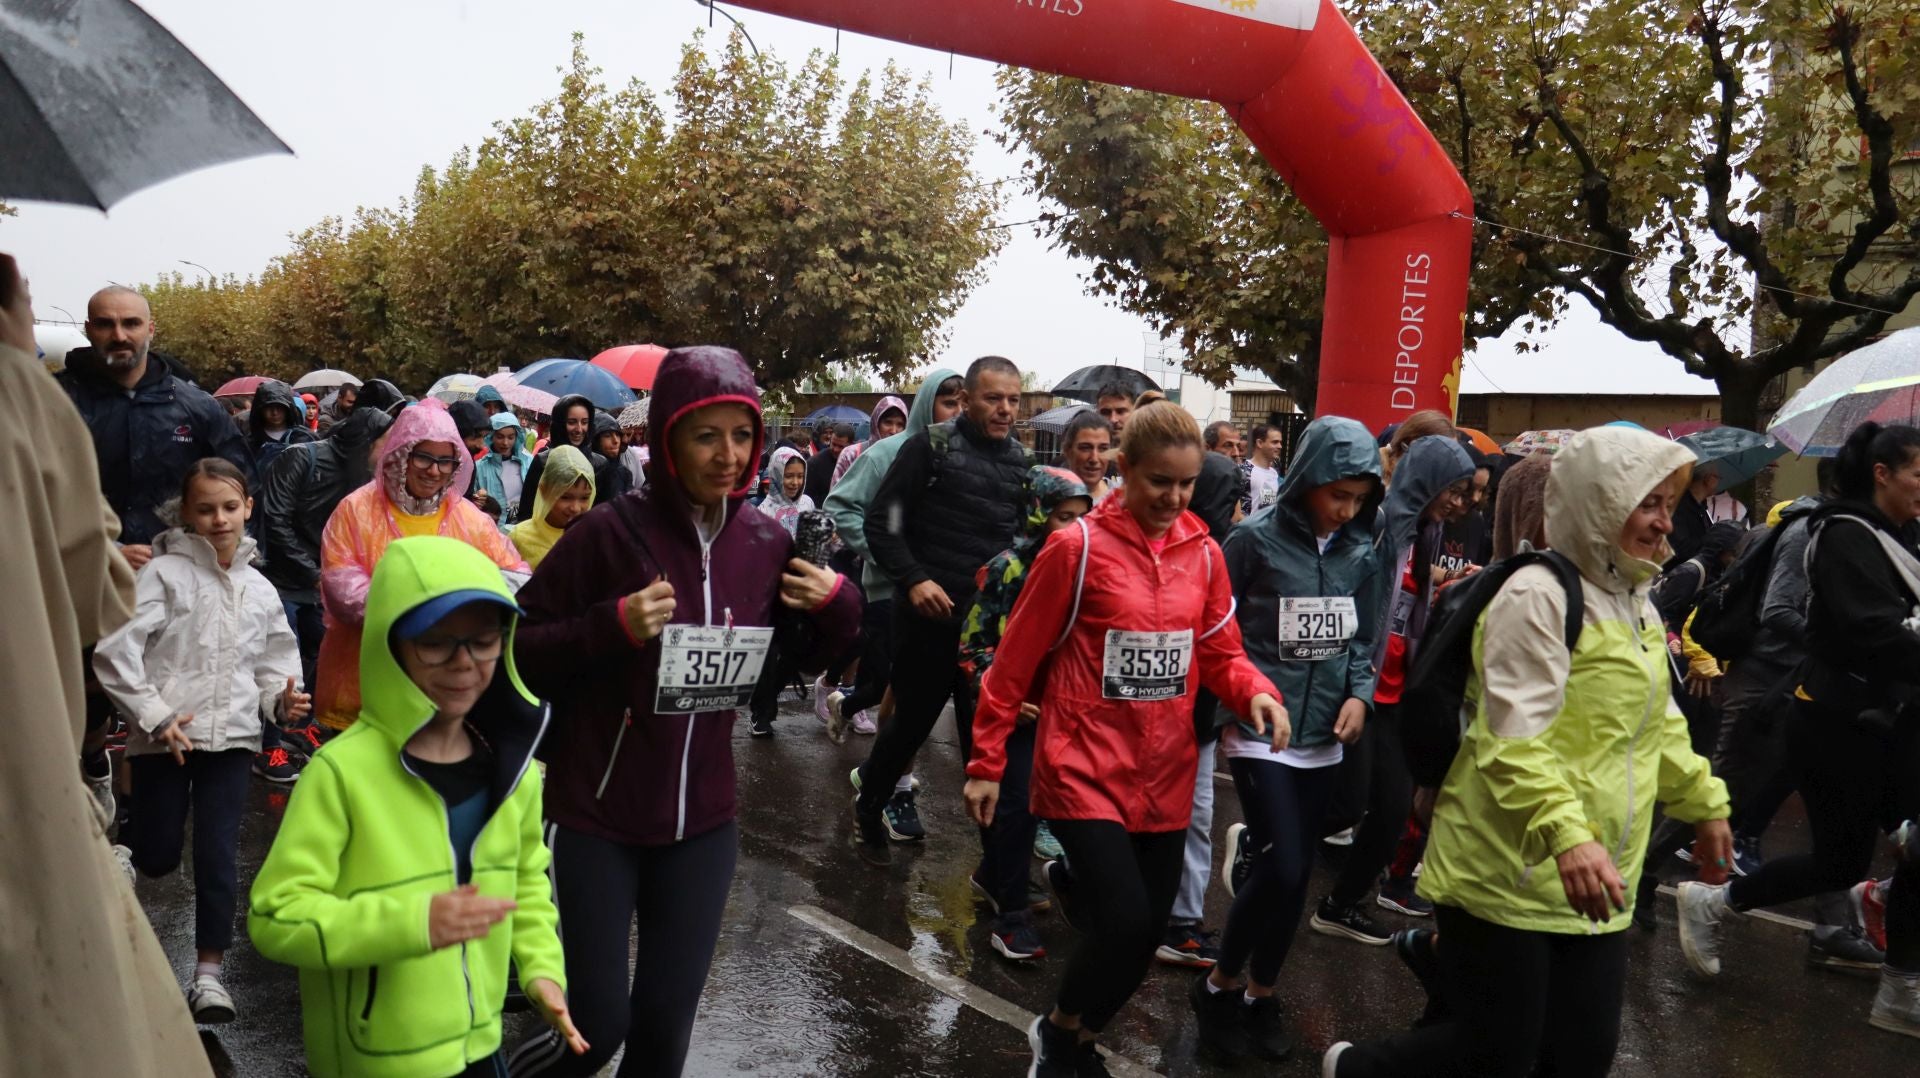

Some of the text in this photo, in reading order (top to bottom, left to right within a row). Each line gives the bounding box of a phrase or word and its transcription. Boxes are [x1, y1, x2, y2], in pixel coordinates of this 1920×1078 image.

[1391, 253, 1431, 409] DEPORTES
[1297, 612, 1343, 639] 3291
[684, 650, 748, 685] 3517
[1120, 648, 1181, 677] 3538
